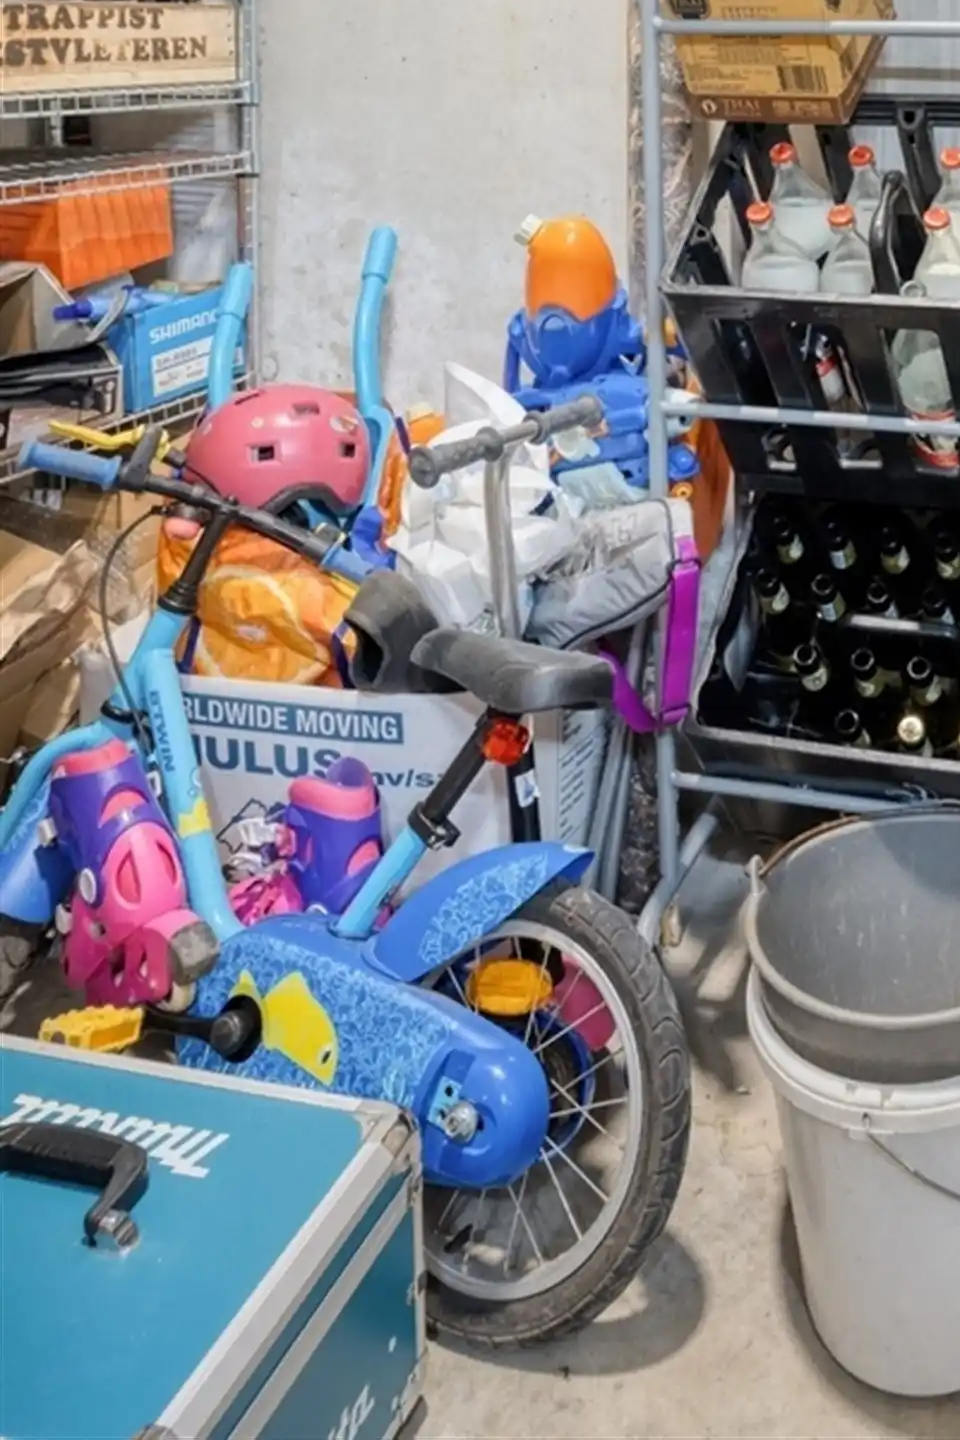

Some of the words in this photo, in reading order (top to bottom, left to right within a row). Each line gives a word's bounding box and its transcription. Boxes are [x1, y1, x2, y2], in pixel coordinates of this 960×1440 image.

[4, 3, 164, 30] TRAPPIST
[0, 35, 207, 67] STVLETEREN
[182, 696, 289, 731] RLDWIDE
[296, 710, 399, 740] MOVING
